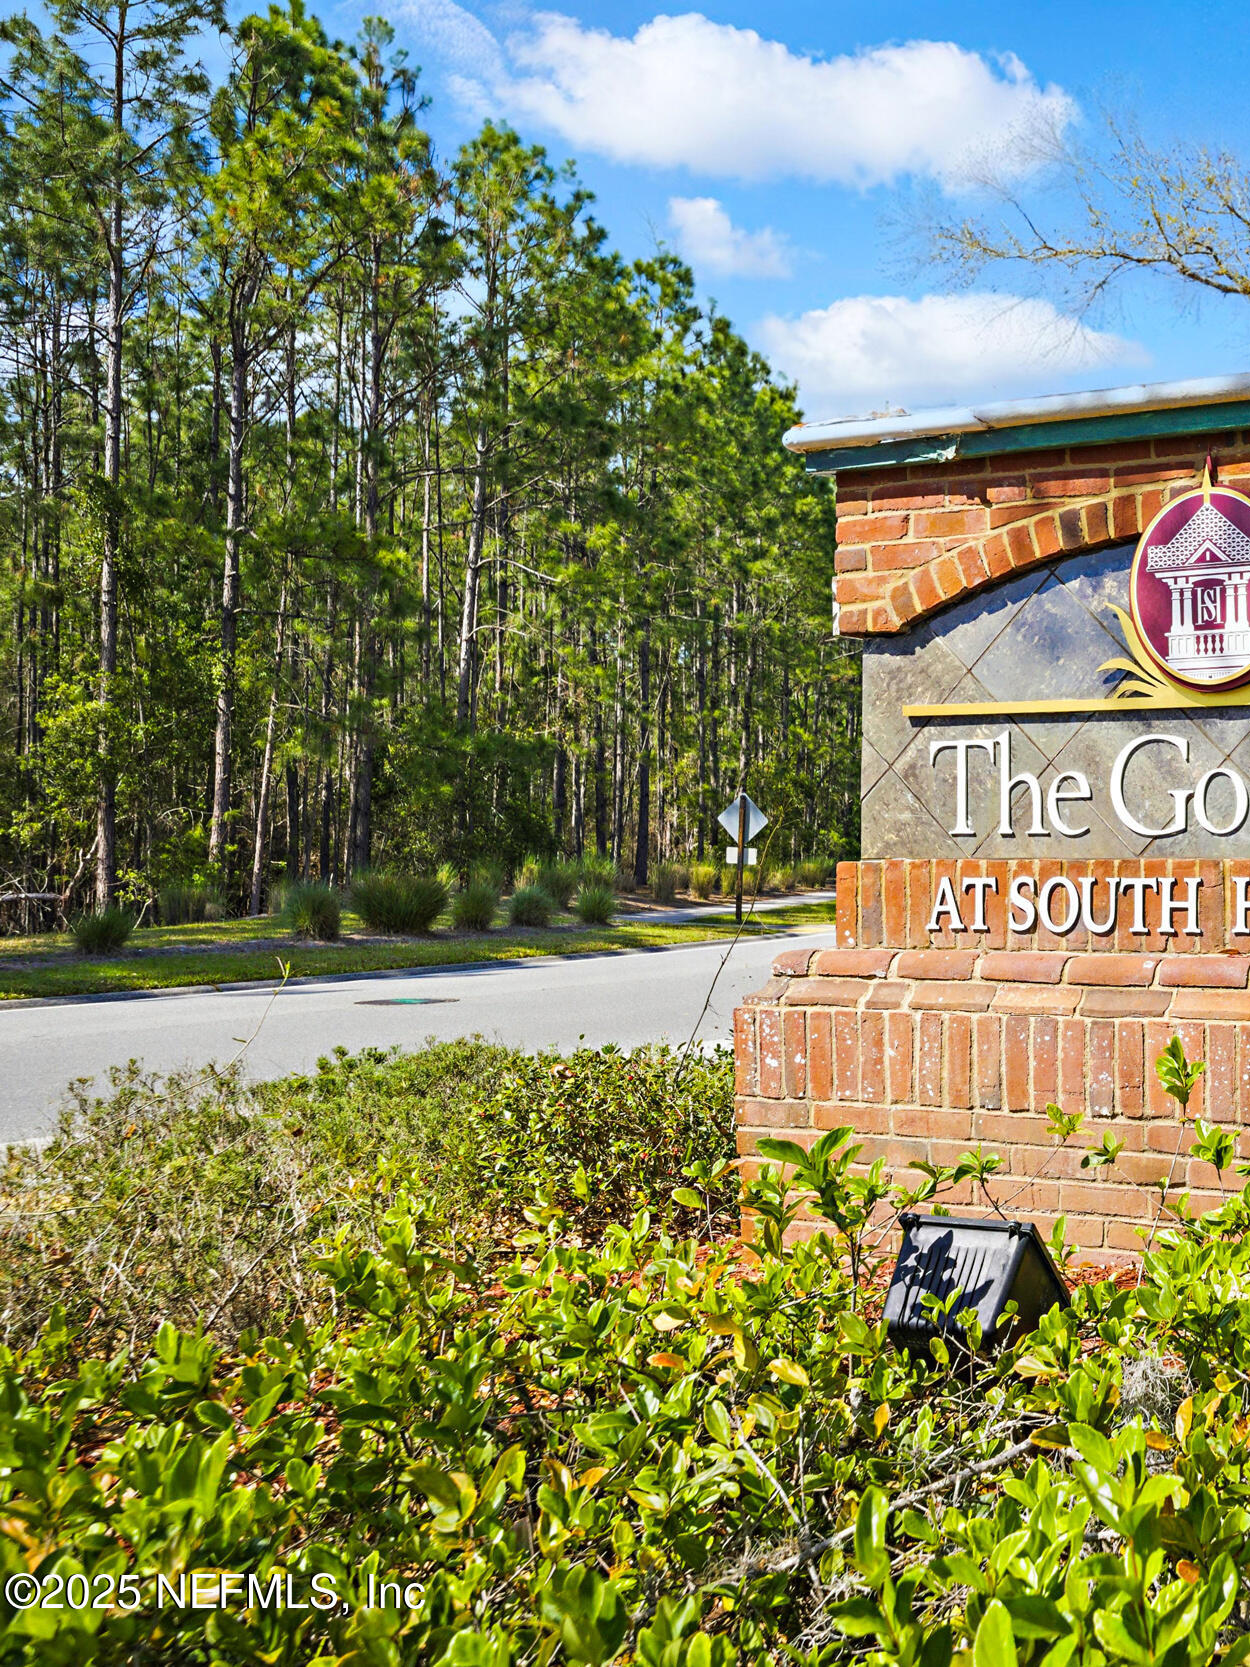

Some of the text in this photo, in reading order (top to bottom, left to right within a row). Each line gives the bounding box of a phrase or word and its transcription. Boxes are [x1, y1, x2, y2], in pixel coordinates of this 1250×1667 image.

[929, 730, 1092, 838] The
[926, 876, 997, 933] AT
[1008, 875, 1203, 937] SOUTH
